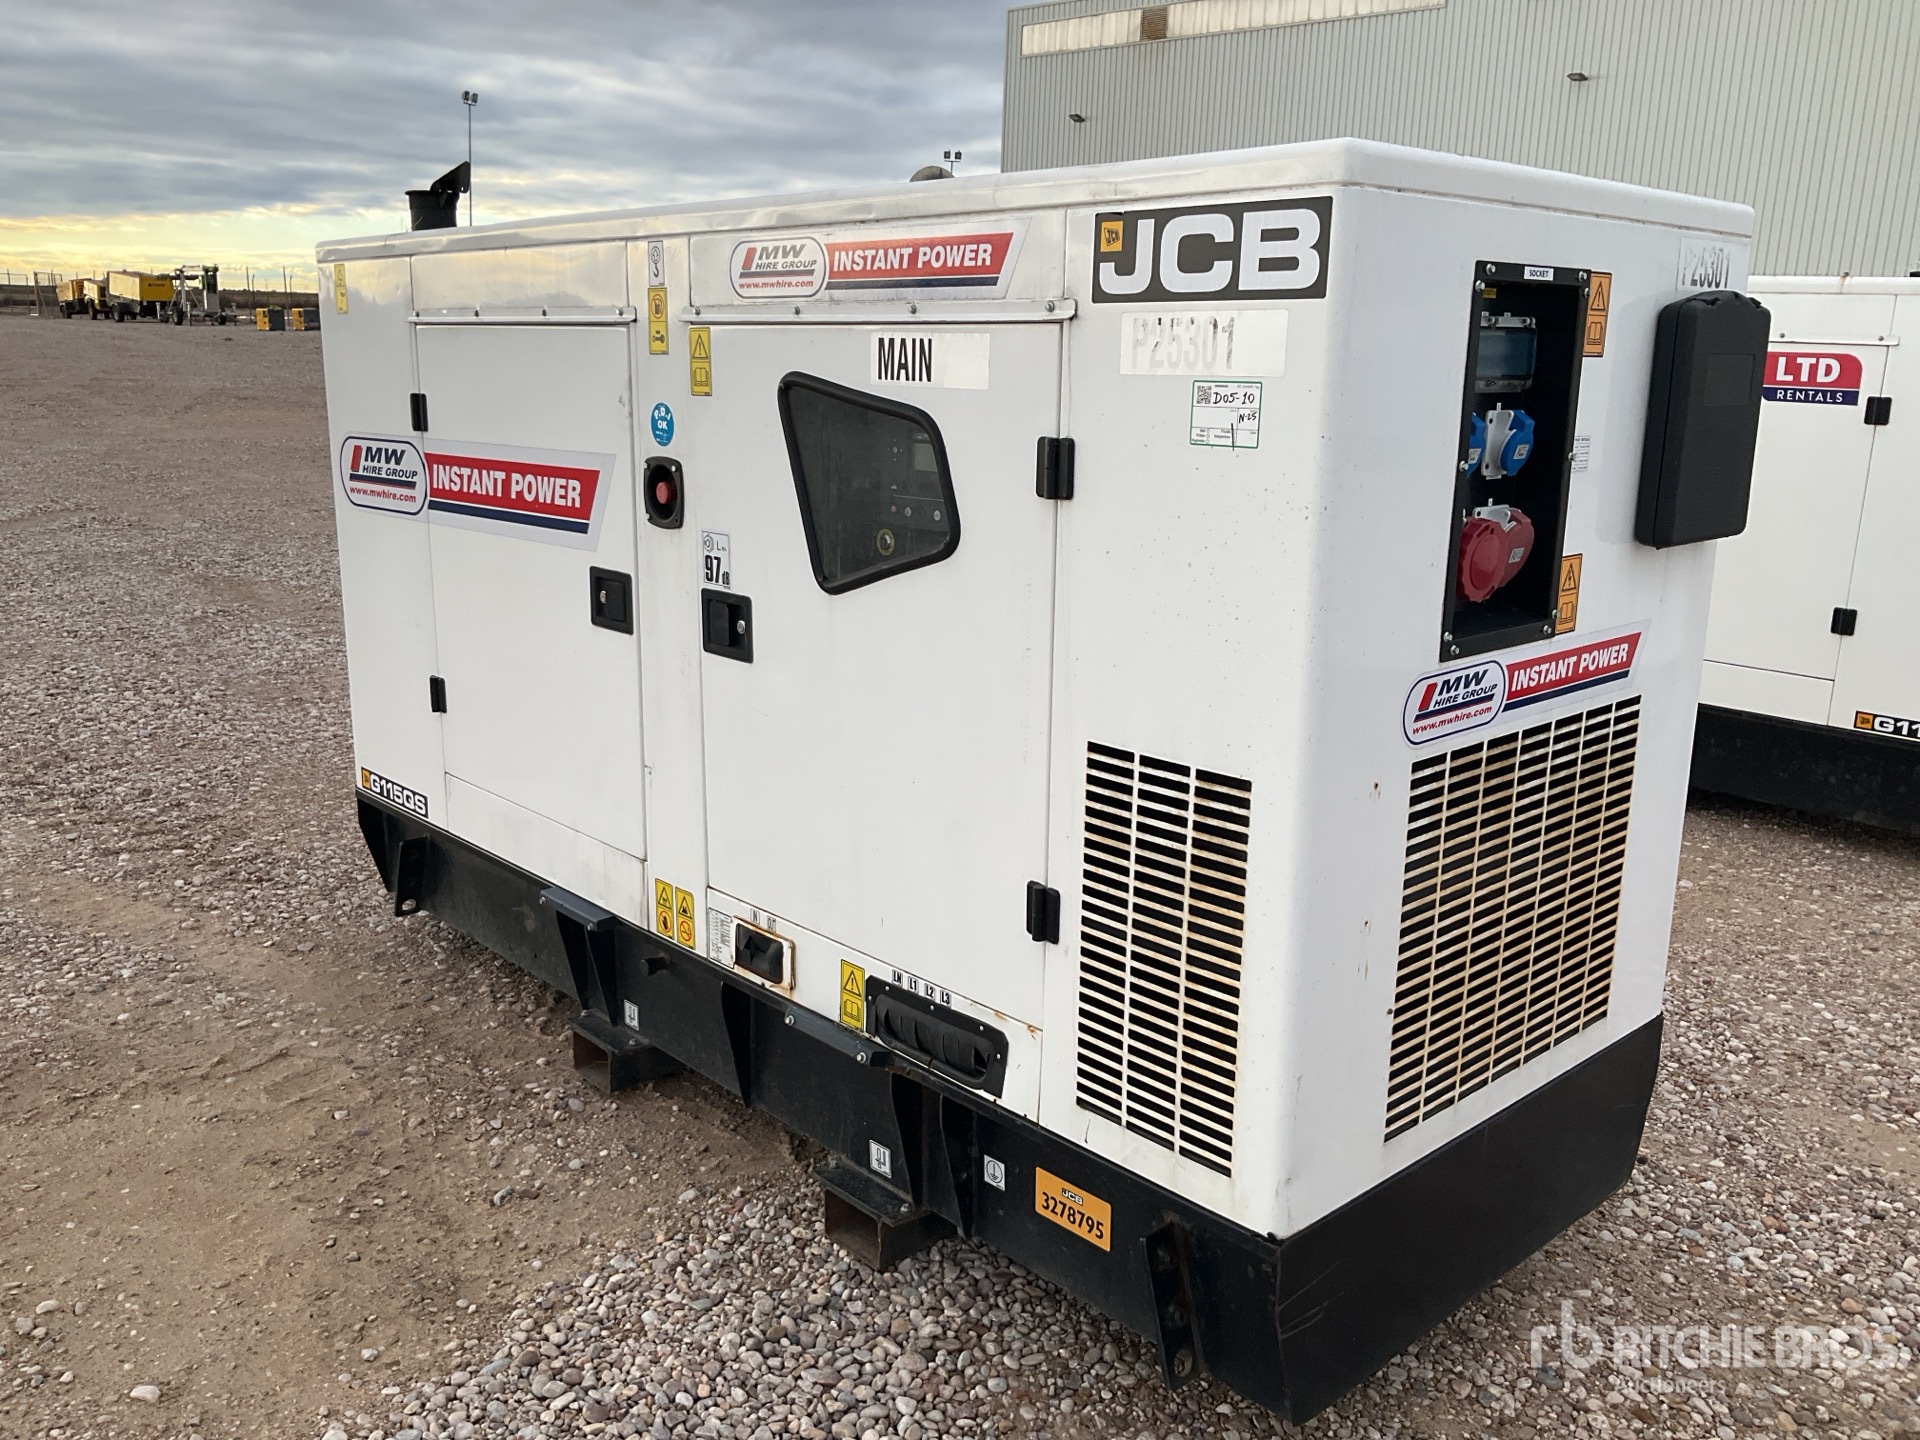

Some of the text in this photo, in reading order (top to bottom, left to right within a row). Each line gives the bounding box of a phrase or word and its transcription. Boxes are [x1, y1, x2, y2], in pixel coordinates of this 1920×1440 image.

[758, 243, 806, 261] MW
[833, 243, 992, 272] INSTANT POWER
[1099, 208, 1321, 295] JCB
[755, 259, 818, 271] HIRE GROUP
[1529, 269, 1549, 278] SOCKET
[738, 278, 814, 290] www.mwhire.com
[1131, 316, 1236, 371] P25301
[877, 337, 932, 382] MAIN
[1775, 356, 1841, 383] LTD
[1776, 389, 1843, 403] RENTALS
[657, 420, 668, 430] OK
[364, 446, 406, 465] MW
[362, 464, 418, 480] HIRE GROUP
[350, 486, 417, 503] www.mwhire.com
[432, 463, 581, 508] INSTANT POWER
[704, 554, 721, 584] 97
[1511, 643, 1629, 692] INSTANT POWER
[1437, 669, 1489, 696] MW
[1433, 683, 1498, 709] HIRE GROUP
[1412, 705, 1492, 735] www.mwhire.com
[370, 773, 427, 815] G115QS
[893, 970, 902, 984] LN
[909, 977, 918, 991] L1
[926, 985, 934, 998] L2
[941, 991, 950, 1005] L3
[1062, 1189, 1083, 1205] JCB
[1042, 1191, 1104, 1240] 3278795
